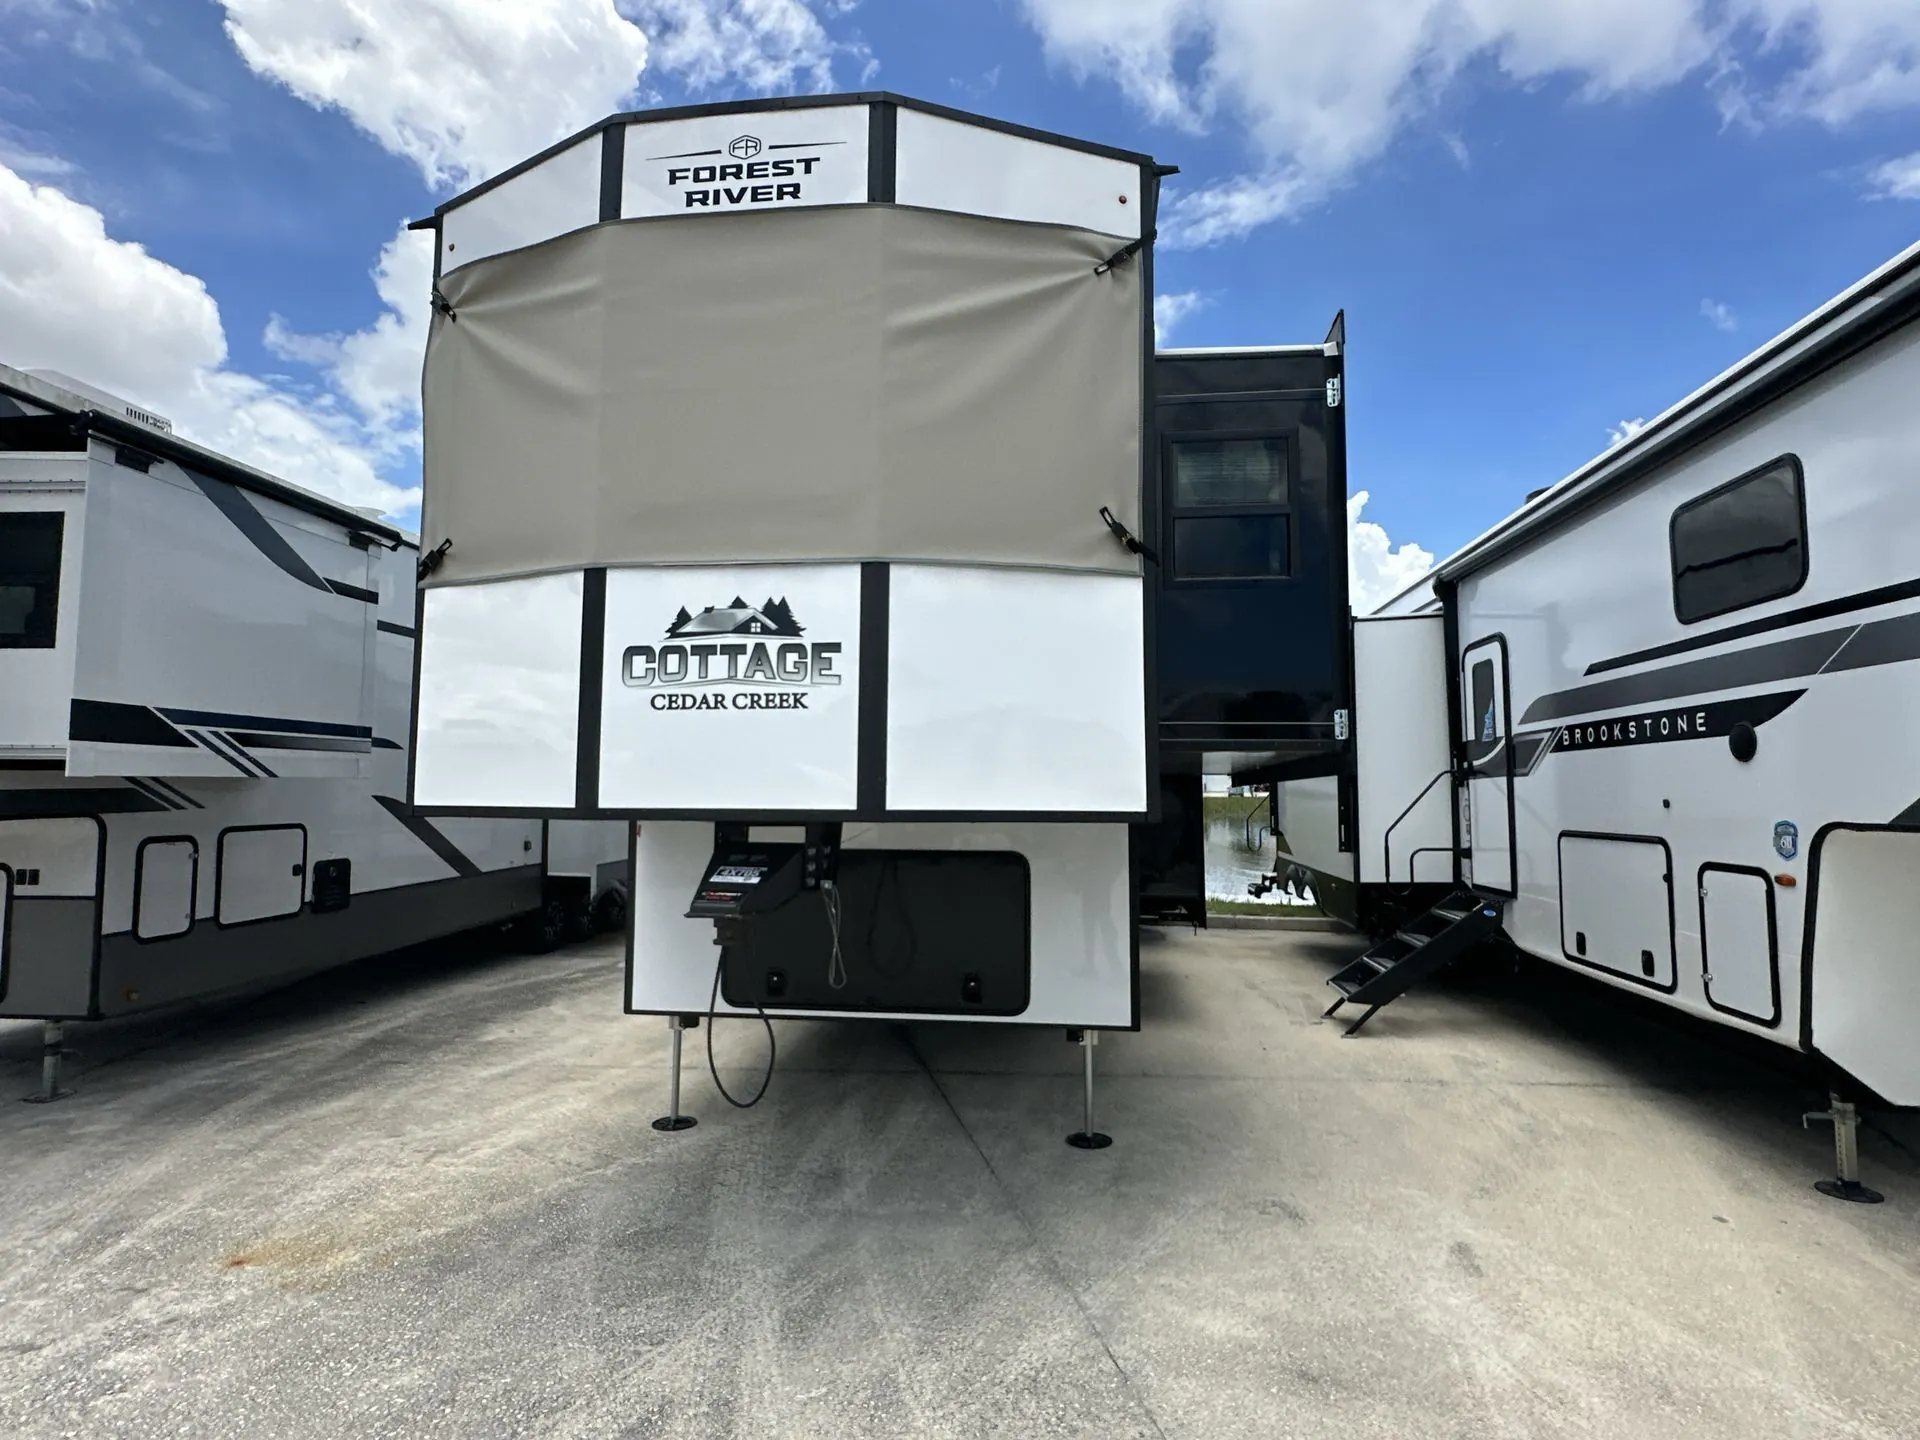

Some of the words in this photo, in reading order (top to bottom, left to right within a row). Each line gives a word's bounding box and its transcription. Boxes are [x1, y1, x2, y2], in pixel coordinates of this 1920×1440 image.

[667, 157, 821, 185] FOREST
[684, 182, 802, 208] RIVER
[622, 642, 842, 687] COTTAGE
[650, 693, 728, 710] CEDAR
[732, 692, 809, 710] CREEK
[1562, 712, 1707, 745] BROOKSTONE
